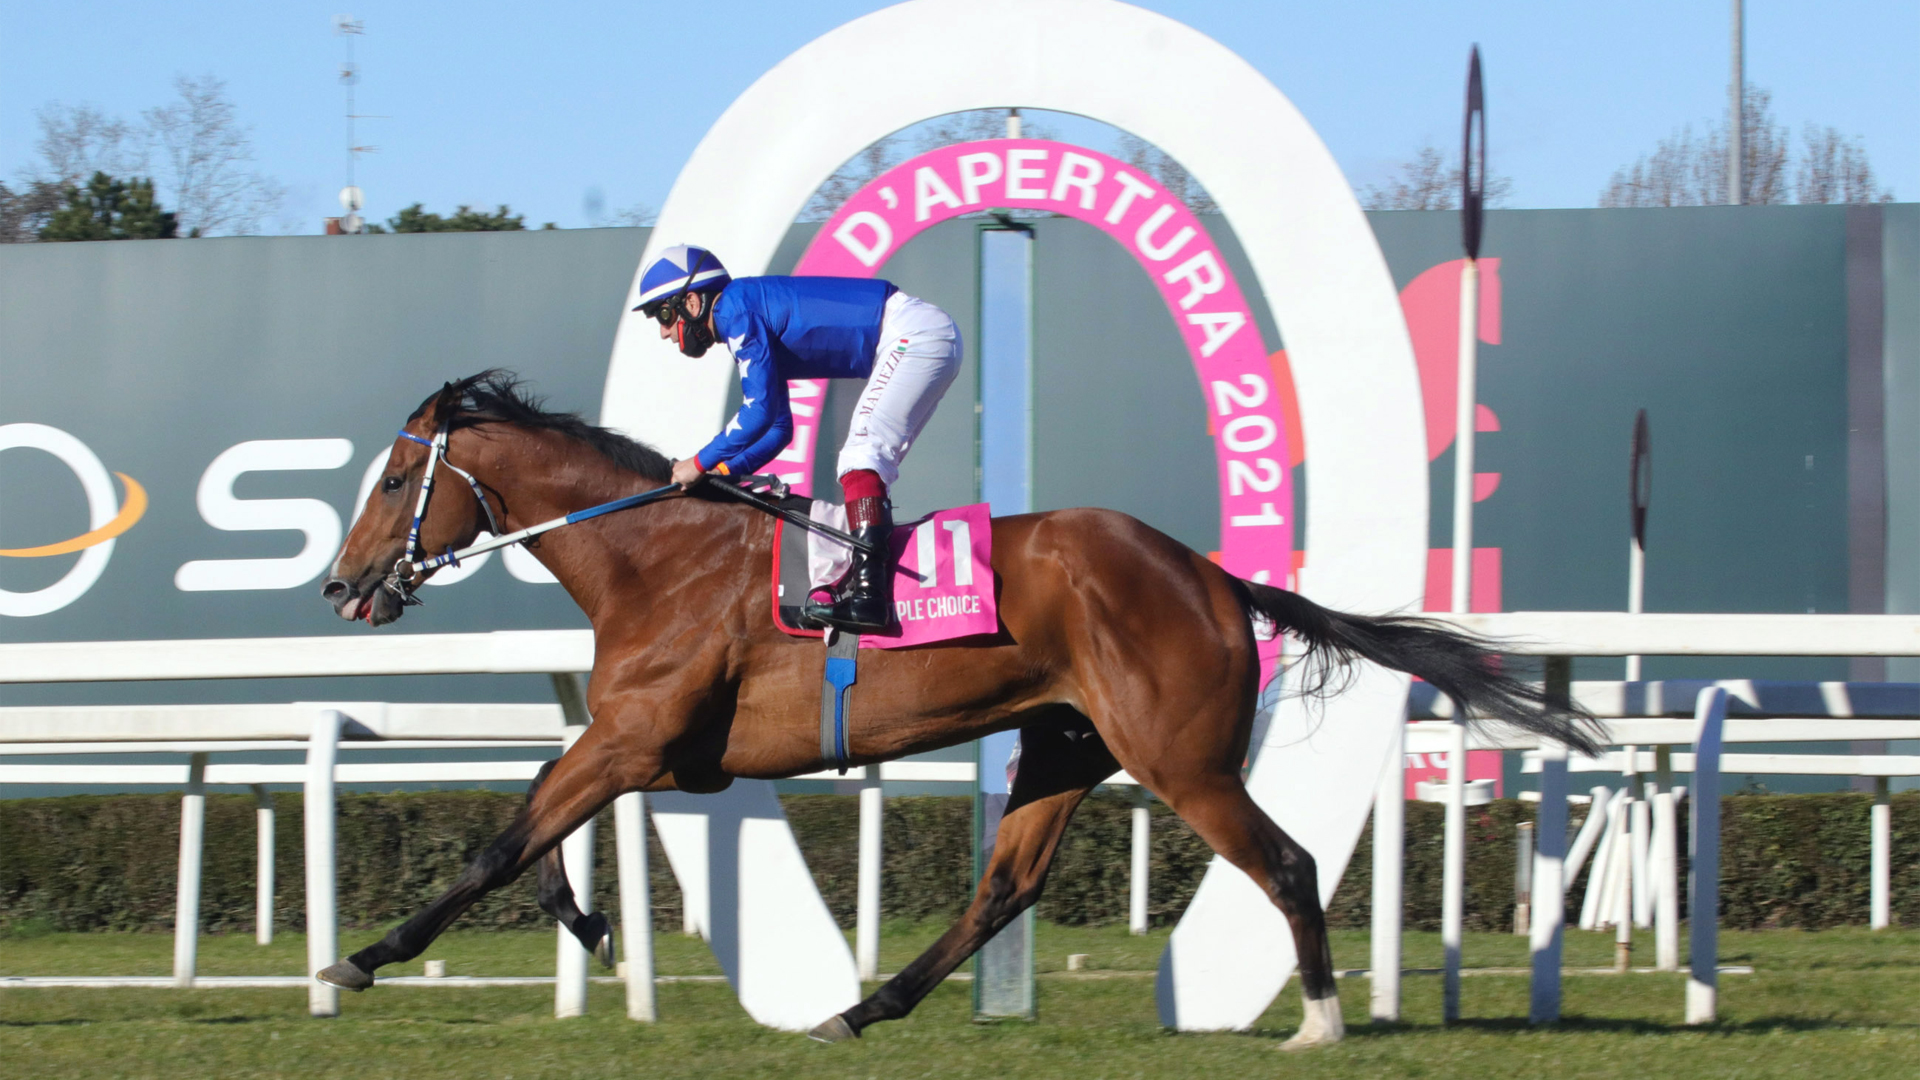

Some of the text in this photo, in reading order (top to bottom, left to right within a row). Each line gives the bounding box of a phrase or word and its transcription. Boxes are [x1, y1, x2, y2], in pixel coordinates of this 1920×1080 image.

[832, 148, 1285, 527] D'APERTURA 2021
[917, 518, 974, 589] 11
[926, 594, 981, 619] CHOICE
